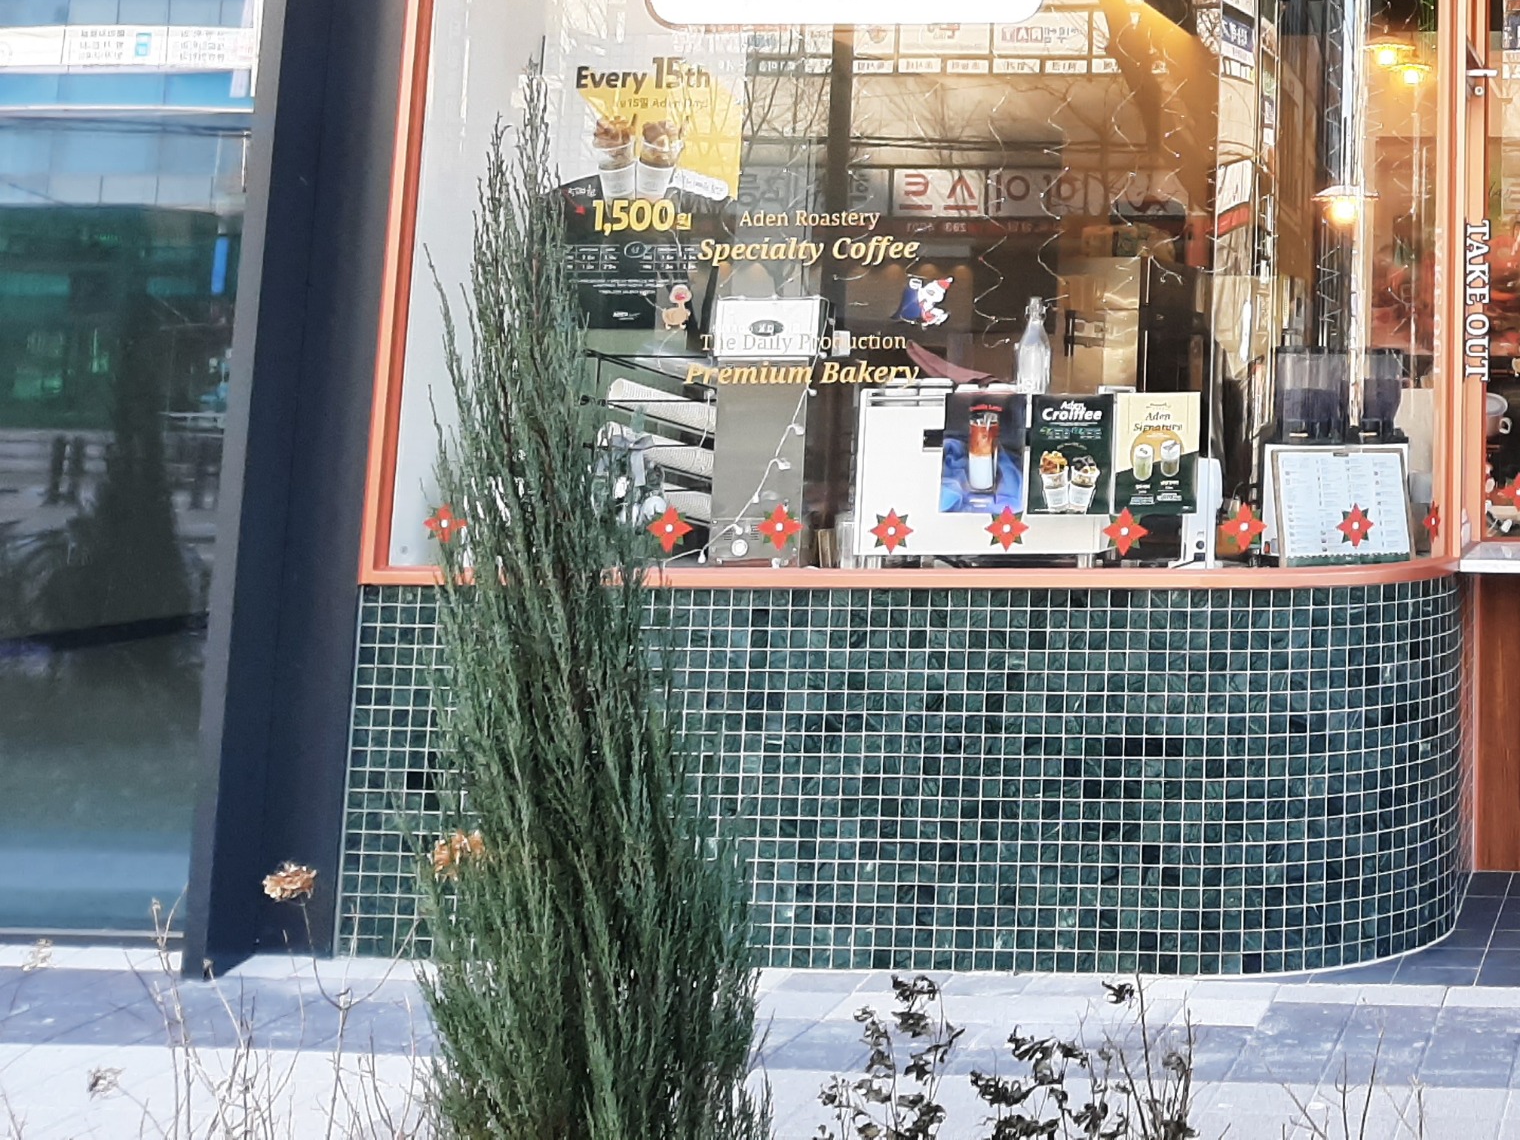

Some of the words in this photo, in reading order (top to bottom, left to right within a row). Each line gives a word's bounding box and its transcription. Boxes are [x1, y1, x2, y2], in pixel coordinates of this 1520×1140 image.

[576, 65, 647, 94] Every
[652, 56, 711, 89] 15th
[739, 210, 789, 227] Aden
[795, 210, 881, 231] Roastery
[697, 236, 825, 266] Specialty
[832, 236, 921, 265] Coffee
[1465, 219, 1490, 306] TAKE
[700, 333, 737, 351] The
[742, 333, 793, 354] Daily
[798, 332, 908, 351] Production
[1465, 313, 1490, 382] OUT
[683, 360, 813, 384] Premium
[820, 361, 920, 388] Bakery
